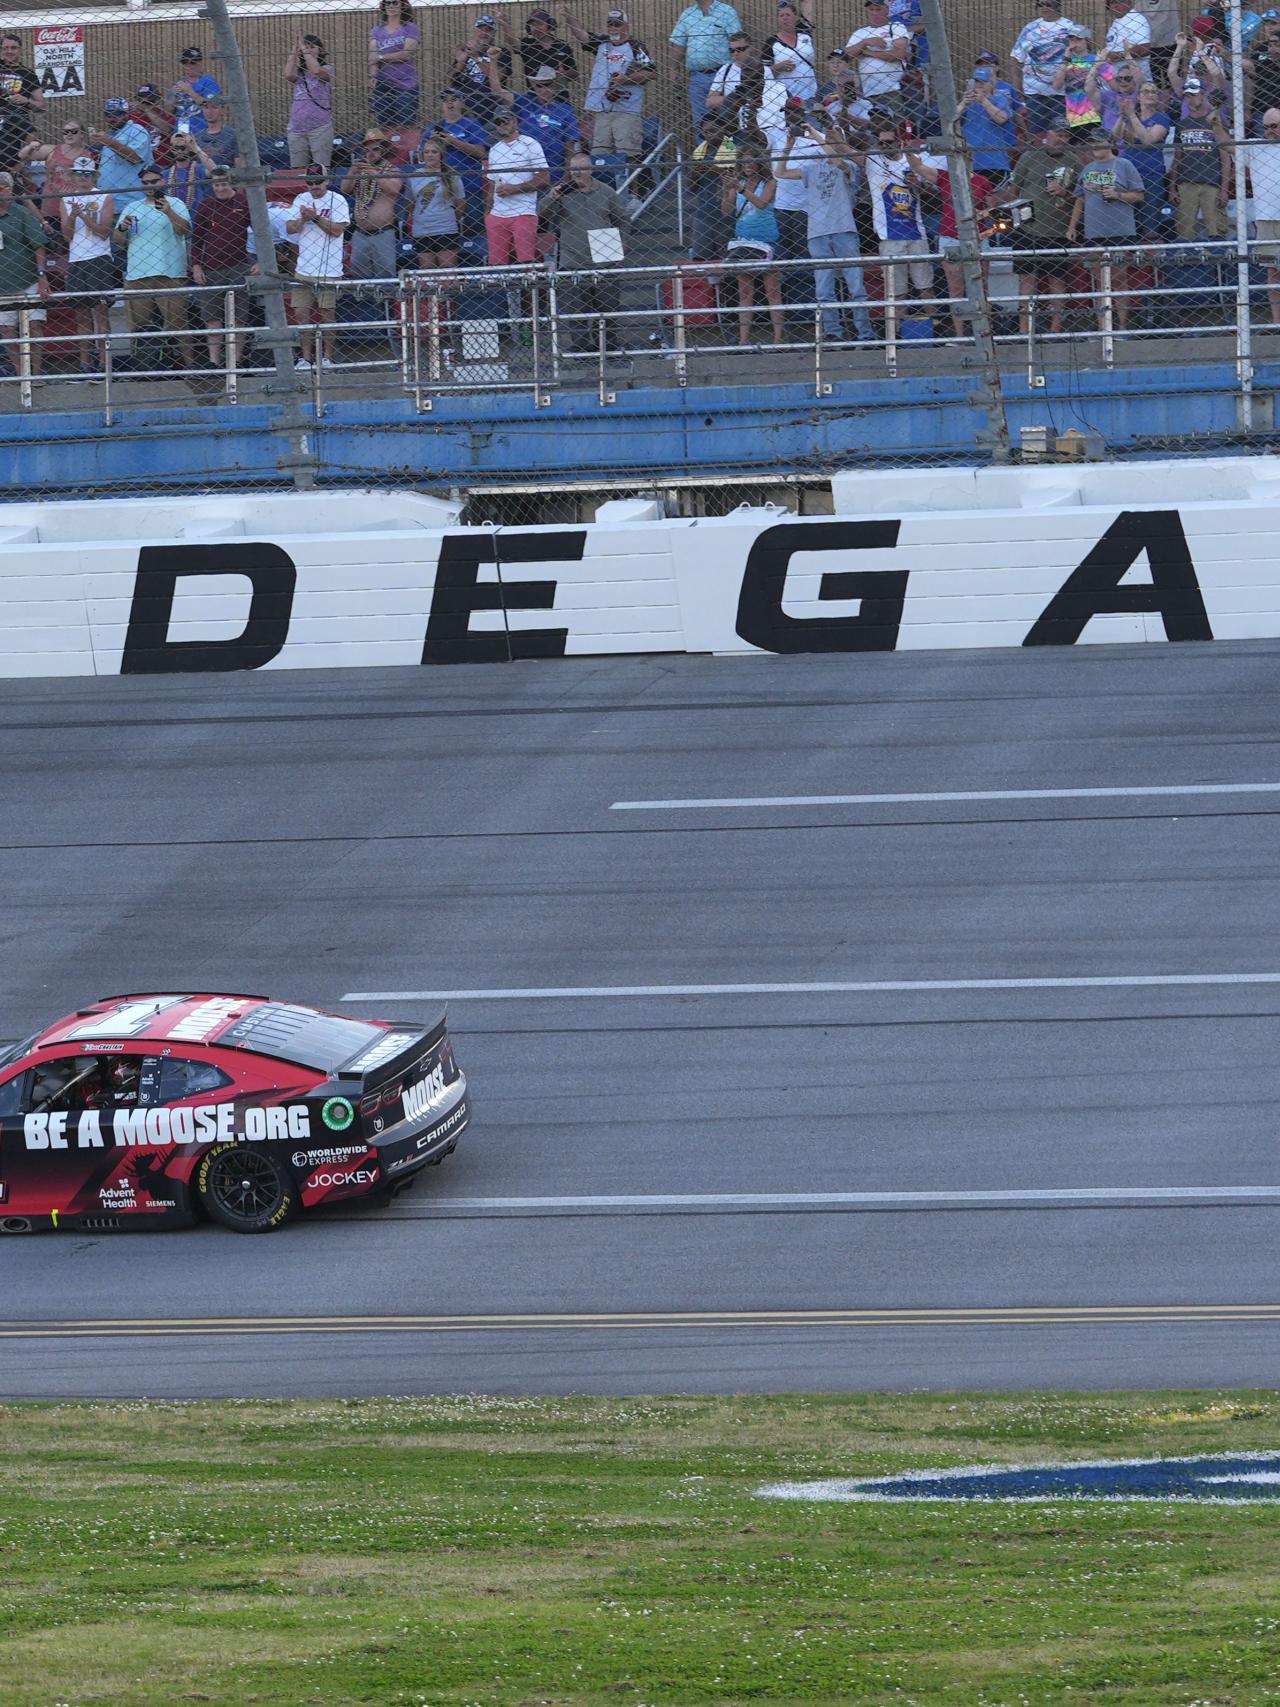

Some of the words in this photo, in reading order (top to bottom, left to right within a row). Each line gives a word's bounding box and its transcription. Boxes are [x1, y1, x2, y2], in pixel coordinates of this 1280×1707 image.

[40, 66, 84, 93] AA
[24, 1111, 69, 1150] BE
[78, 1110, 105, 1148] A
[113, 1103, 311, 1147] MOOSE.ORG
[416, 1103, 466, 1149] CAMARO
[307, 1145, 368, 1158] WORLDWIDE
[309, 1155, 349, 1166] EXPRESS
[307, 1170, 377, 1188] JOCKEY
[99, 1188, 135, 1198] Advent
[102, 1198, 137, 1208] Health
